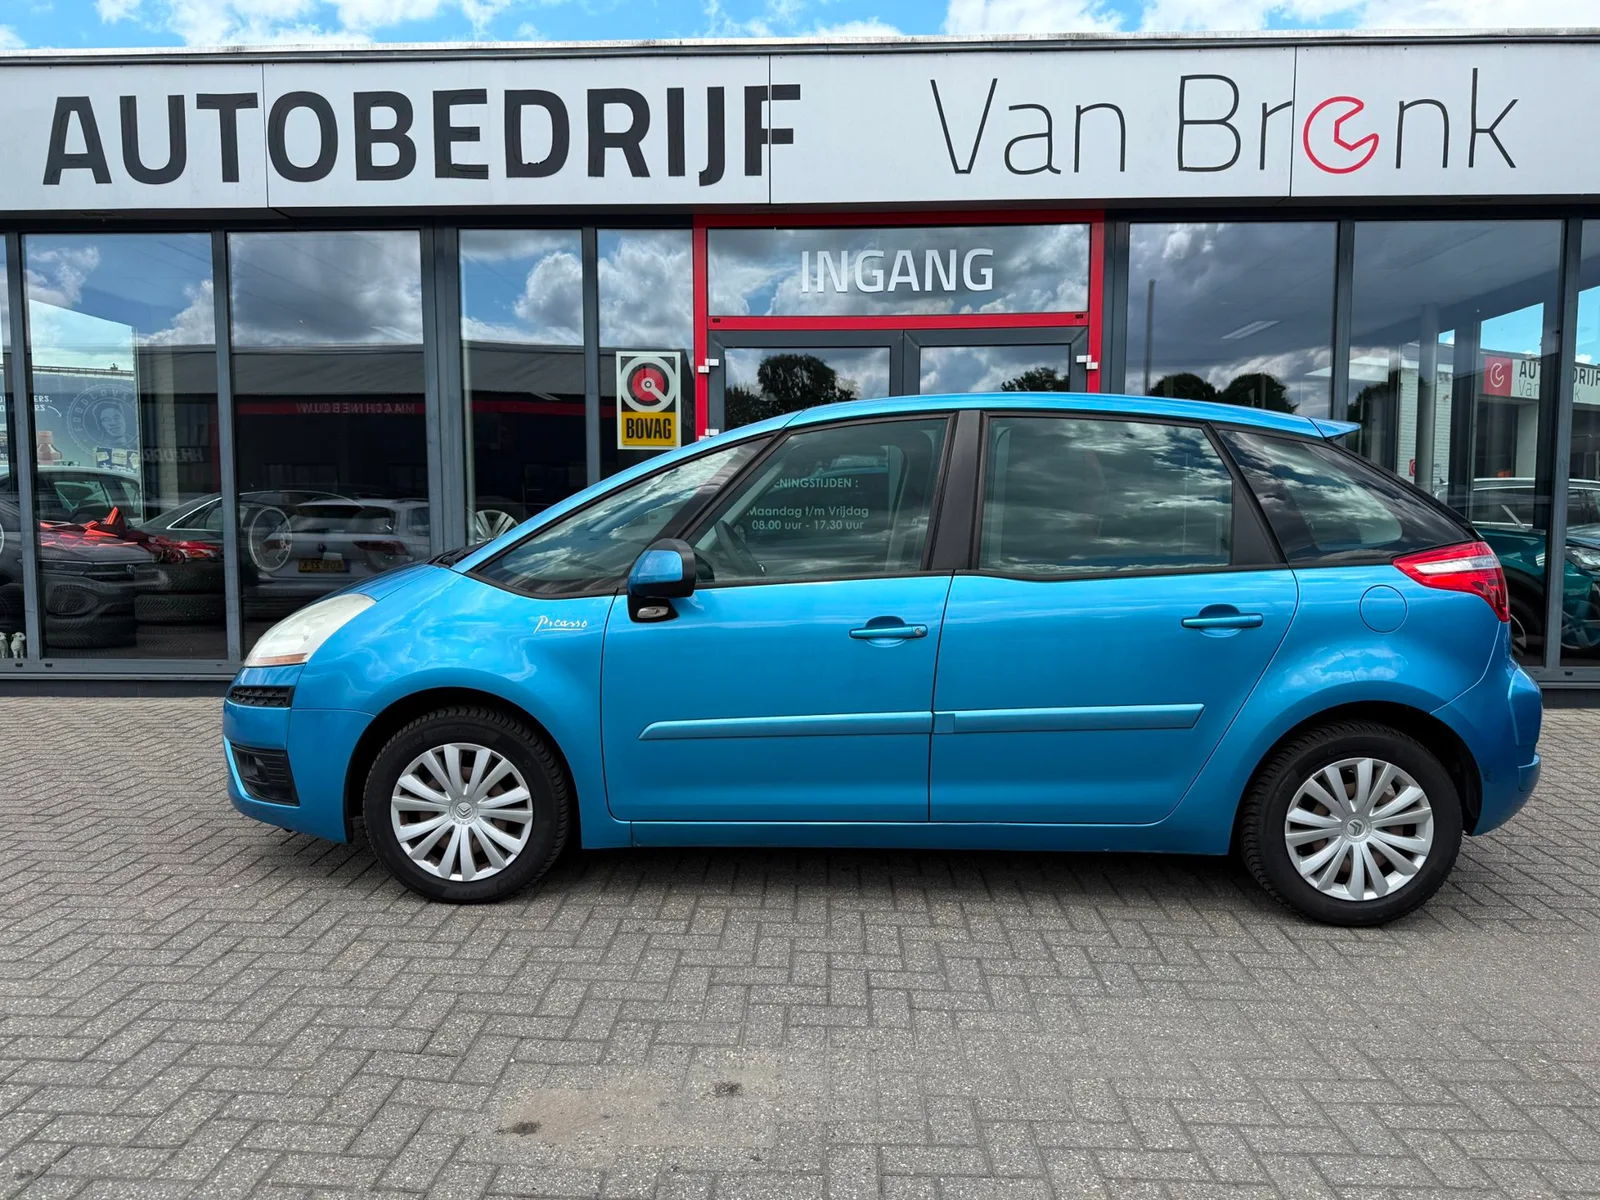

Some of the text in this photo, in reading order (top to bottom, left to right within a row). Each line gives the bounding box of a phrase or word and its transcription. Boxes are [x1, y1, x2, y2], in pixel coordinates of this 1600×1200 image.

[43, 86, 801, 186] AUTOBEDRIJF
[930, 76, 1126, 174] Van
[800, 248, 994, 294] INGANG
[625, 417, 673, 440] BOVAG
[746, 506, 869, 518] Maandag t/m Vrijdag
[751, 520, 782, 530] 08.00
[785, 521, 803, 530] uur
[814, 520, 843, 530] 17.30
[845, 521, 864, 530] uur
[532, 615, 589, 635] Picasso
